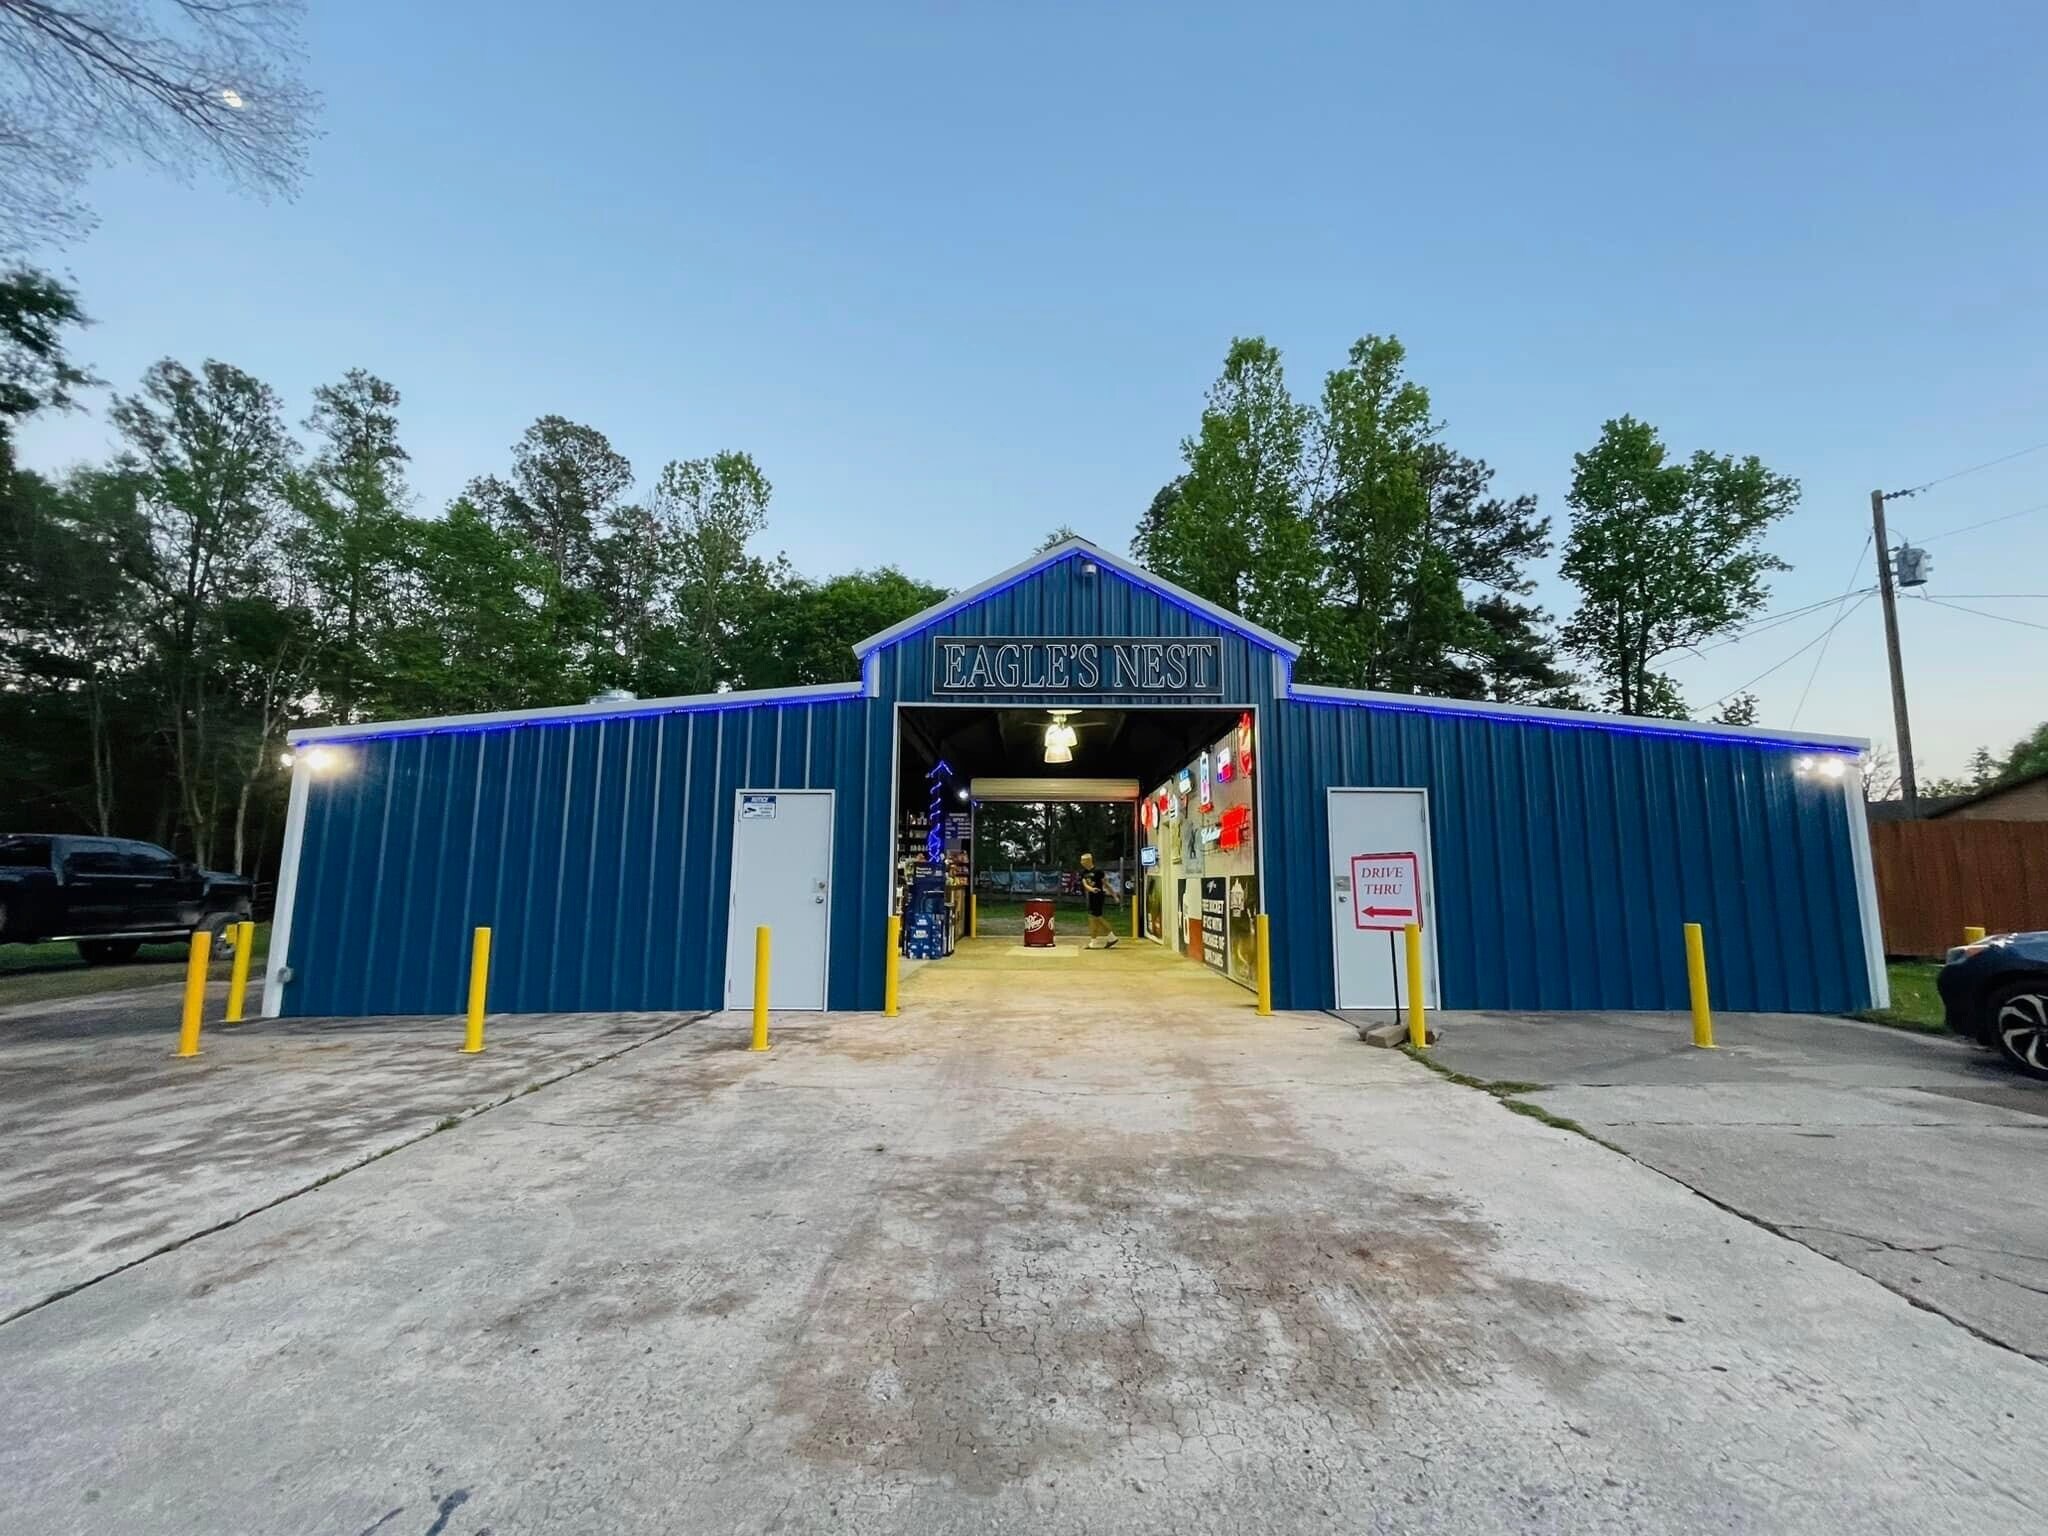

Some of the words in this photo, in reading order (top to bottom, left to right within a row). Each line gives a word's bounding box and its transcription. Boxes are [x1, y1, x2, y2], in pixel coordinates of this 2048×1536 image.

[943, 644, 1100, 688] EAGLE'S
[1113, 644, 1212, 688] NEST
[1361, 867, 1404, 878] DRIVE
[1364, 883, 1402, 895] THRU
